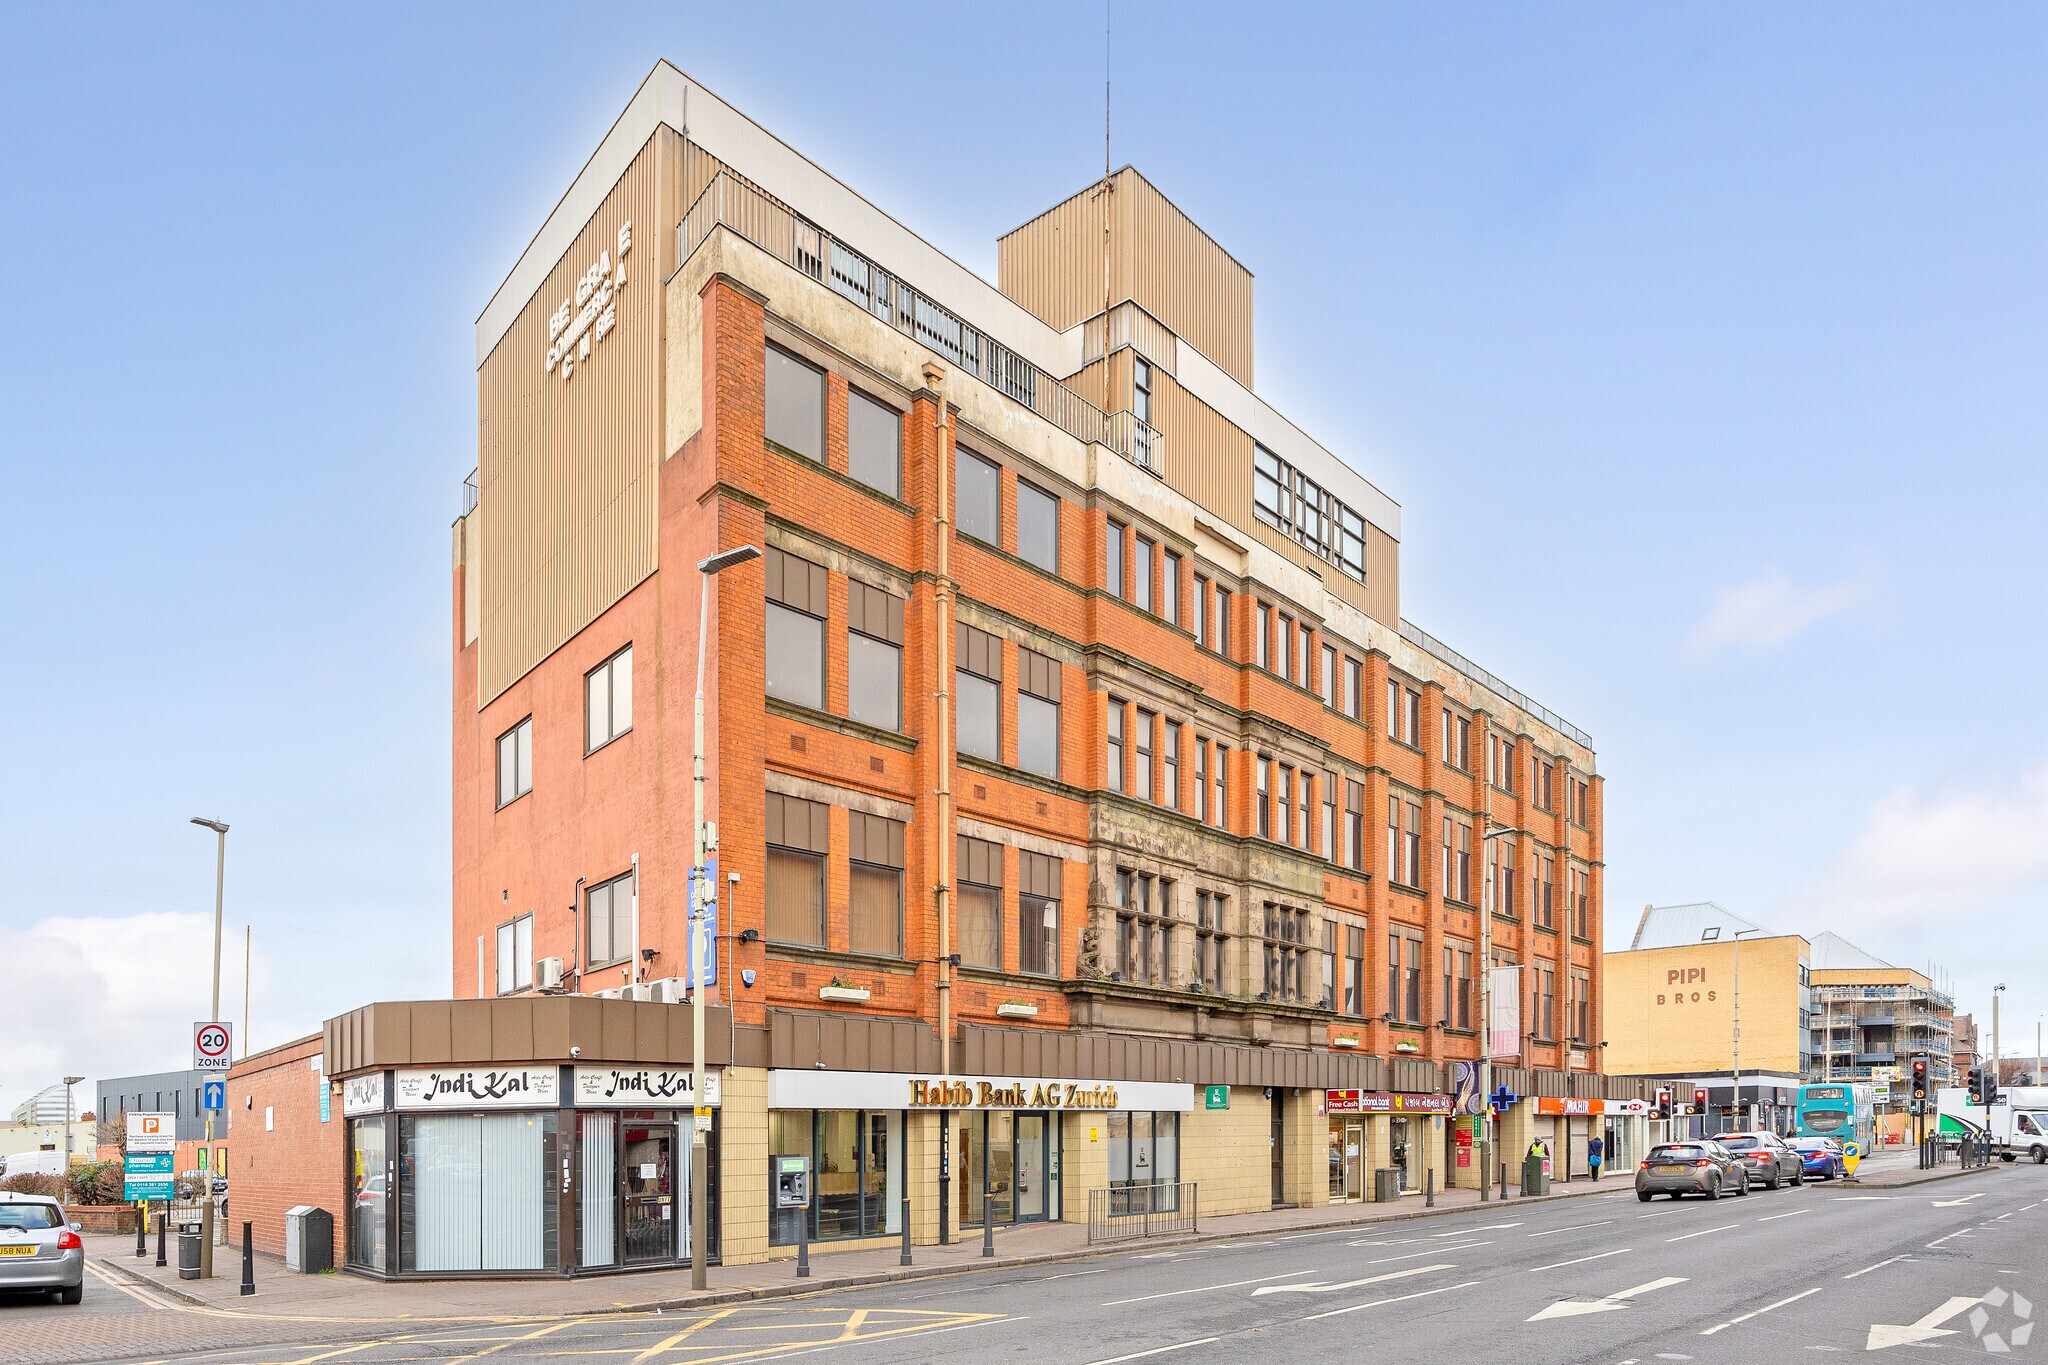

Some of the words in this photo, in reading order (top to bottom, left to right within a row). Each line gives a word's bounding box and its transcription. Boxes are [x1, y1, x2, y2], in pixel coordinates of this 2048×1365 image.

[1668, 967, 1706, 985] PIPI
[1657, 990, 1717, 1005] BROS
[202, 1034, 225, 1047] 20
[197, 1058, 227, 1067] ZONE
[908, 1079, 973, 1106] Habib
[976, 1081, 1028, 1106] Bank
[1030, 1082, 1061, 1106] AG
[1063, 1084, 1119, 1108] Zurich
[1566, 1099, 1589, 1113] MAHIR
[145, 1119, 157, 1132] P
